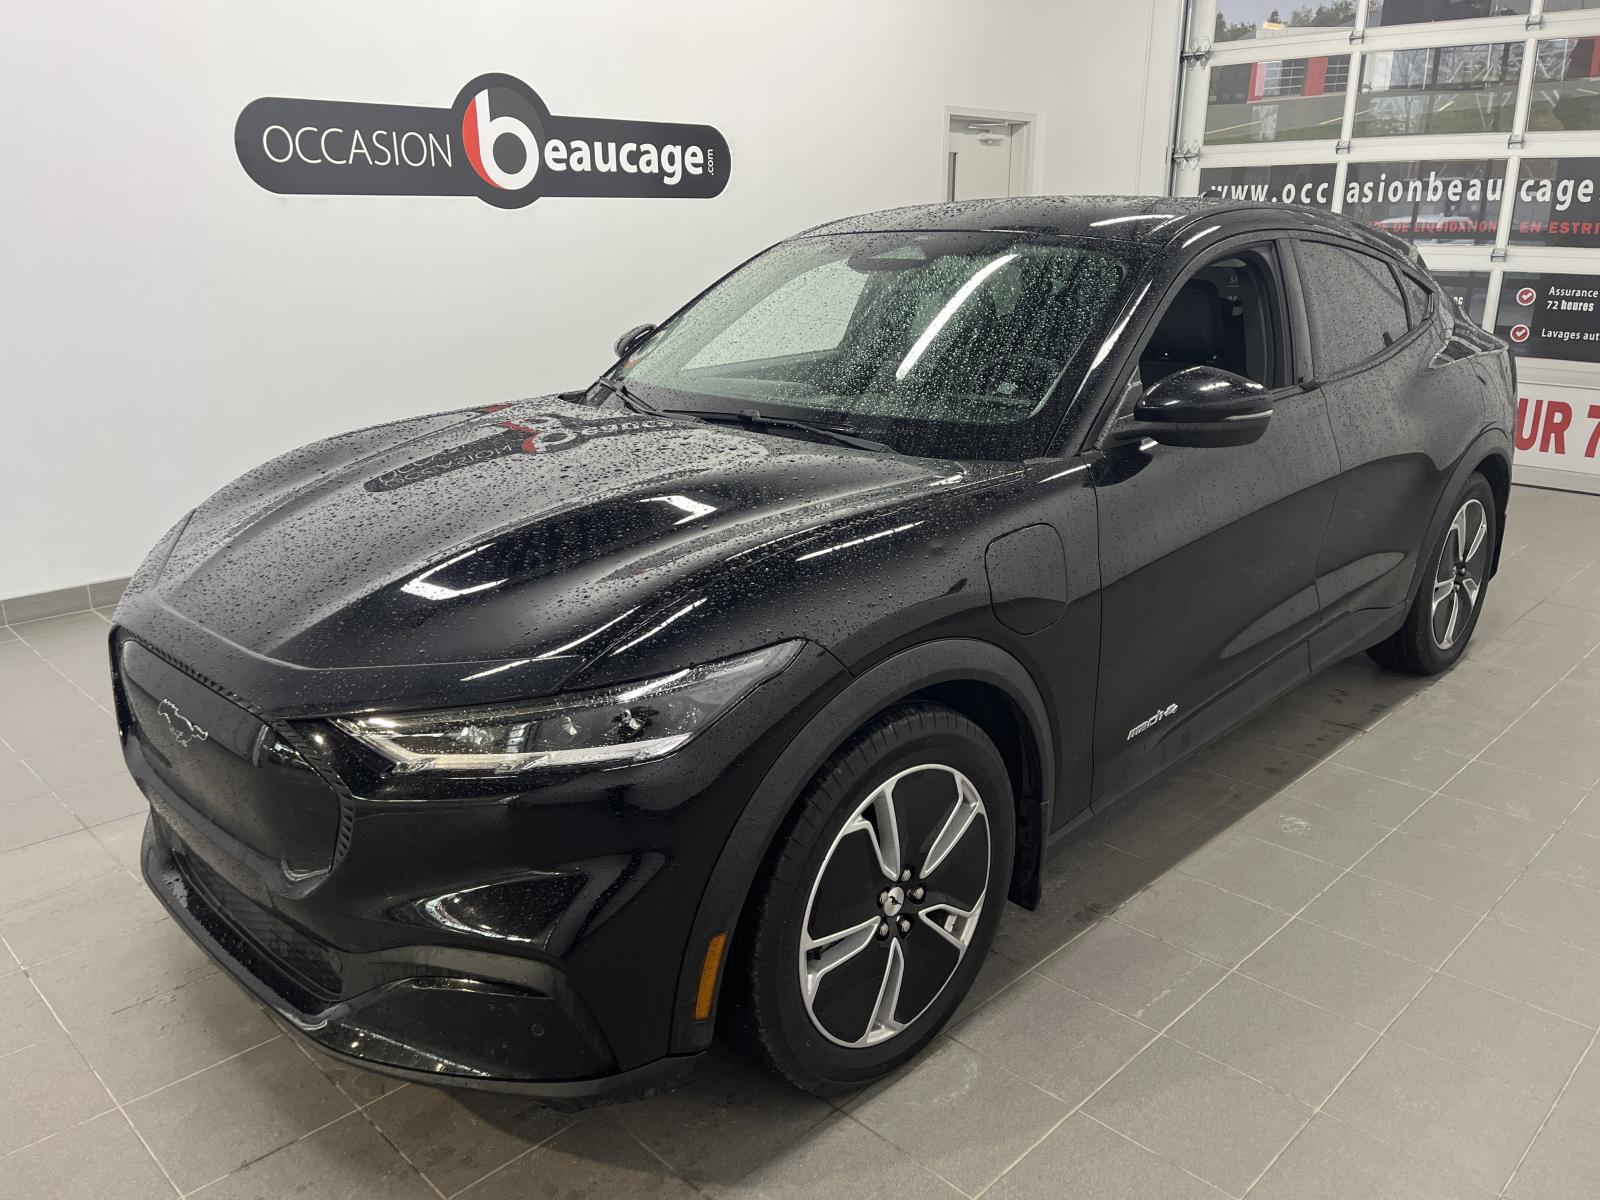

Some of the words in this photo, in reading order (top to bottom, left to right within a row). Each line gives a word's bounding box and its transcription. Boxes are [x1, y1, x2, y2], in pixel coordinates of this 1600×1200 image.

[262, 124, 453, 168] OCCASION
[707, 148, 715, 176] .com
[1519, 221, 1542, 234] EN
[1548, 286, 1599, 298] Assurance
[1546, 300, 1559, 310] 72
[1560, 299, 1595, 312] heures
[1541, 327, 1581, 341] Lavages
